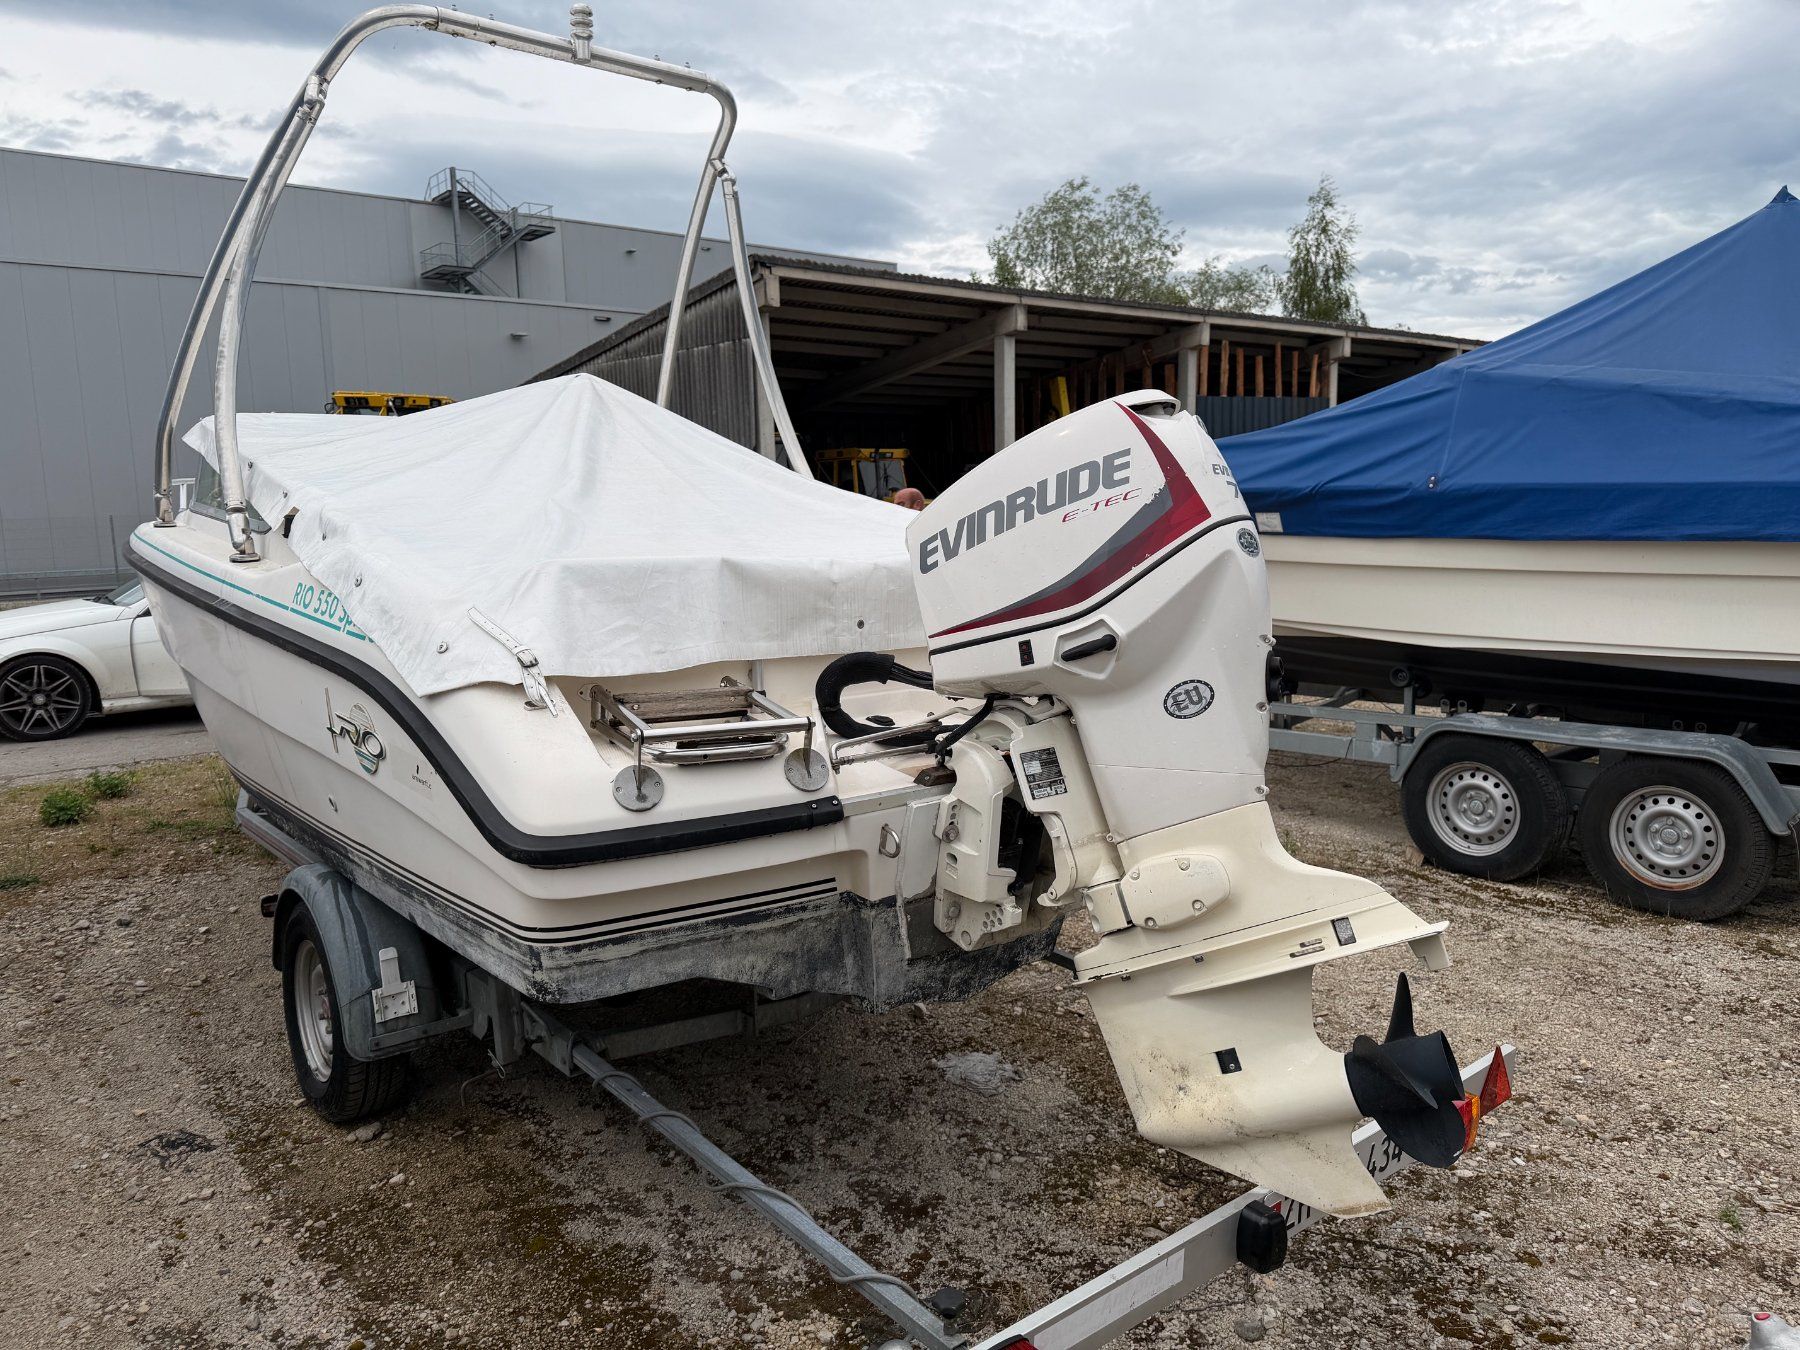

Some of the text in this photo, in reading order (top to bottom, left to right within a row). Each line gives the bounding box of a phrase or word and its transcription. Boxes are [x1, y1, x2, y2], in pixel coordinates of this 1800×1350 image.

[919, 447, 1131, 575] EVINRUDE
[1061, 487, 1142, 523] E-TEC
[293, 582, 314, 610] RIO
[313, 589, 340, 620] 550
